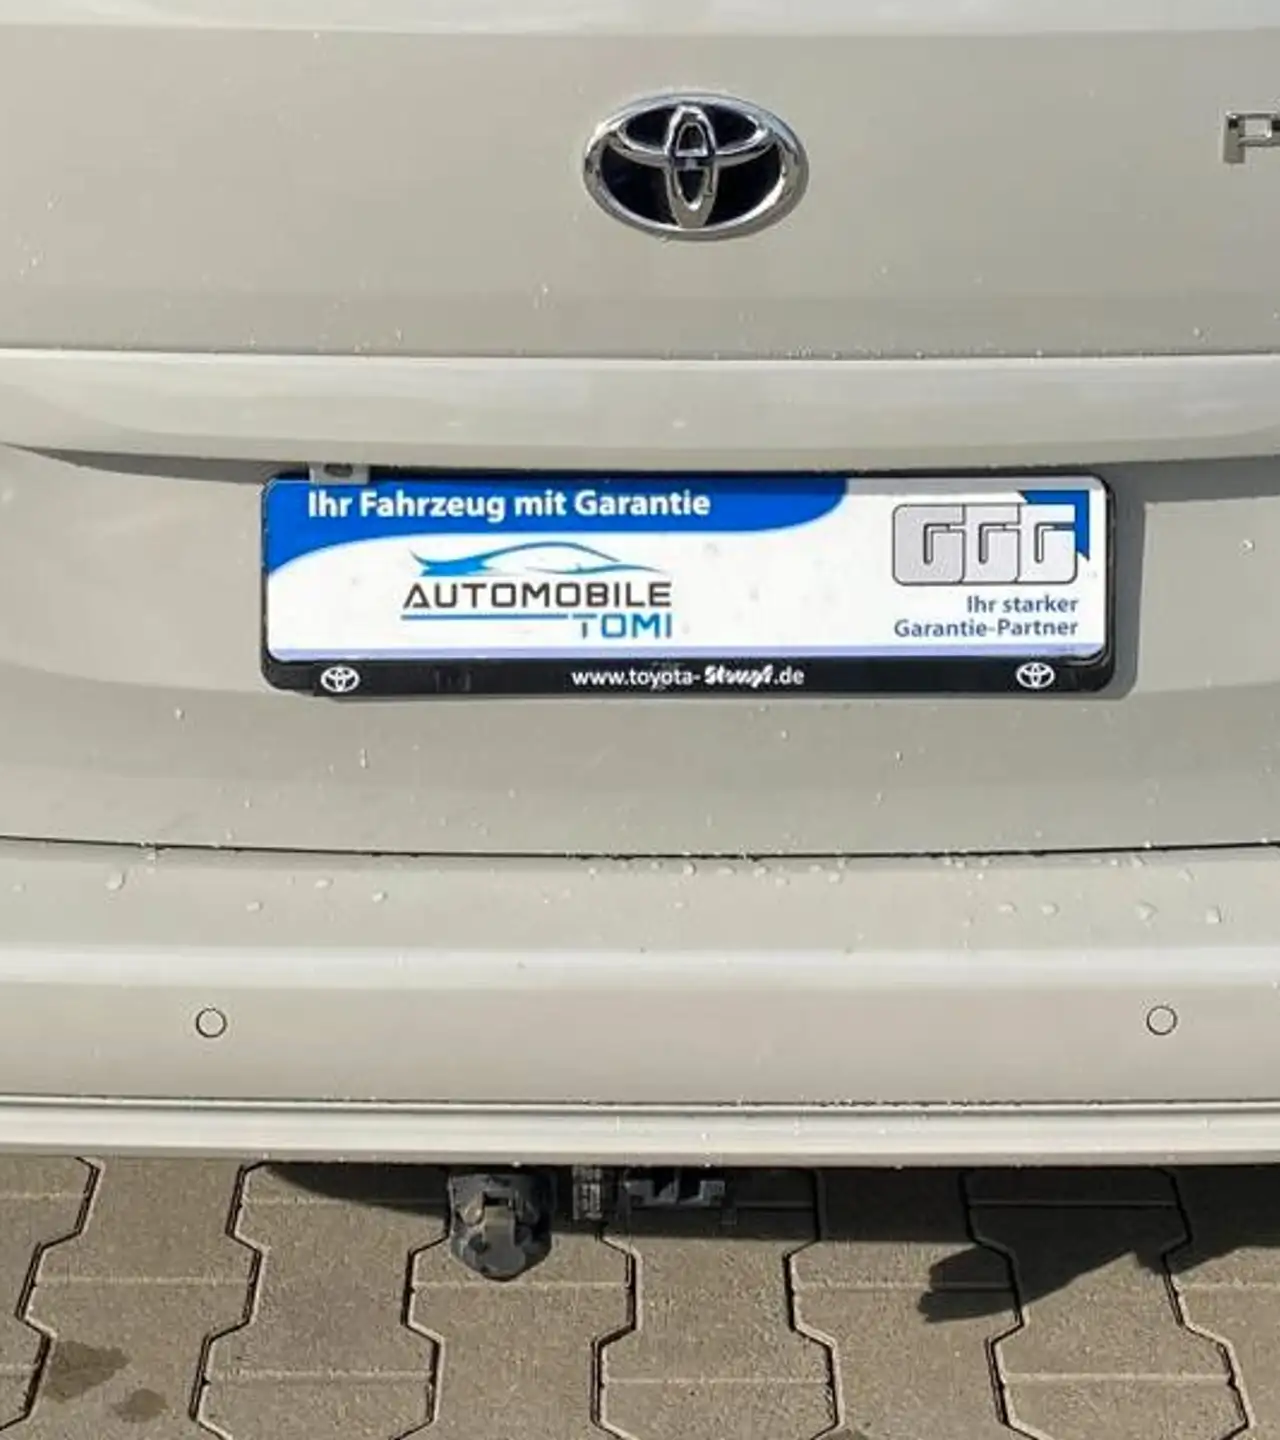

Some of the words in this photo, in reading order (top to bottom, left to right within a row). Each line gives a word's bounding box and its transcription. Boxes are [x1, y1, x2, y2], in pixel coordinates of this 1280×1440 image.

[308, 490, 352, 518] Ihr
[360, 490, 506, 522] Fahrzeug
[515, 490, 567, 516] mit
[575, 489, 711, 516] Garantie
[403, 582, 672, 609] AUTOMOBILE
[967, 596, 995, 613] Ihr
[1002, 595, 1080, 613] starker
[573, 613, 672, 639] TOMI
[894, 618, 1080, 637] Garantie-Partner
